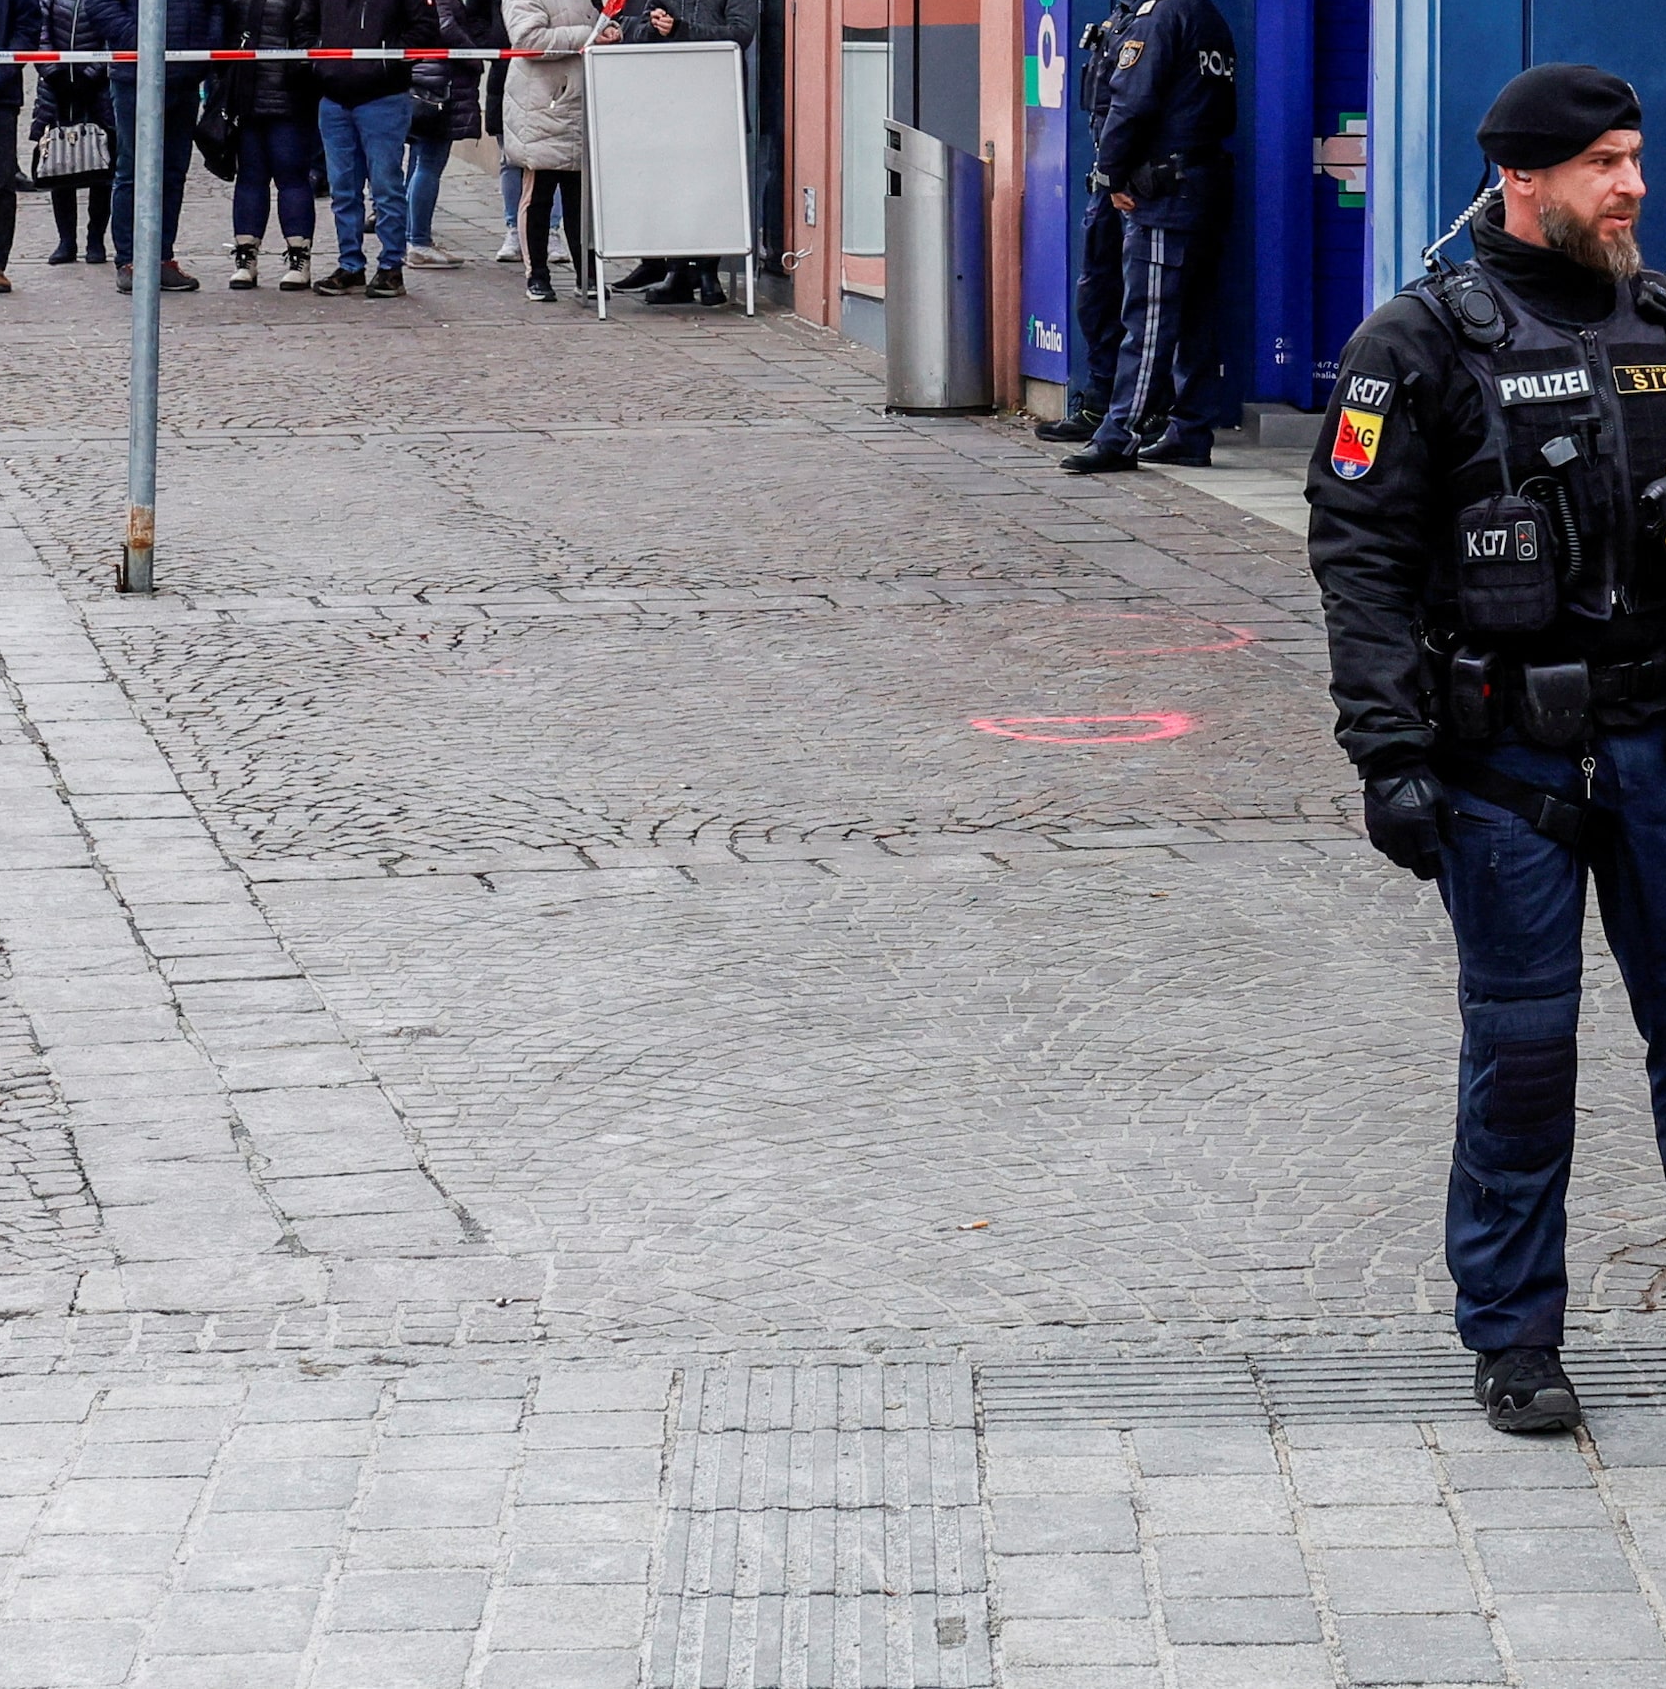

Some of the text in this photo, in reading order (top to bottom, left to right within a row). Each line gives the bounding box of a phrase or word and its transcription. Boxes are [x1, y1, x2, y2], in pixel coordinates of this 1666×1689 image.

[1198, 50, 1235, 77] POL
[1035, 320, 1062, 353] Thalia
[1500, 370, 1590, 401] POLIZEI
[1341, 425, 1375, 448] SIG
